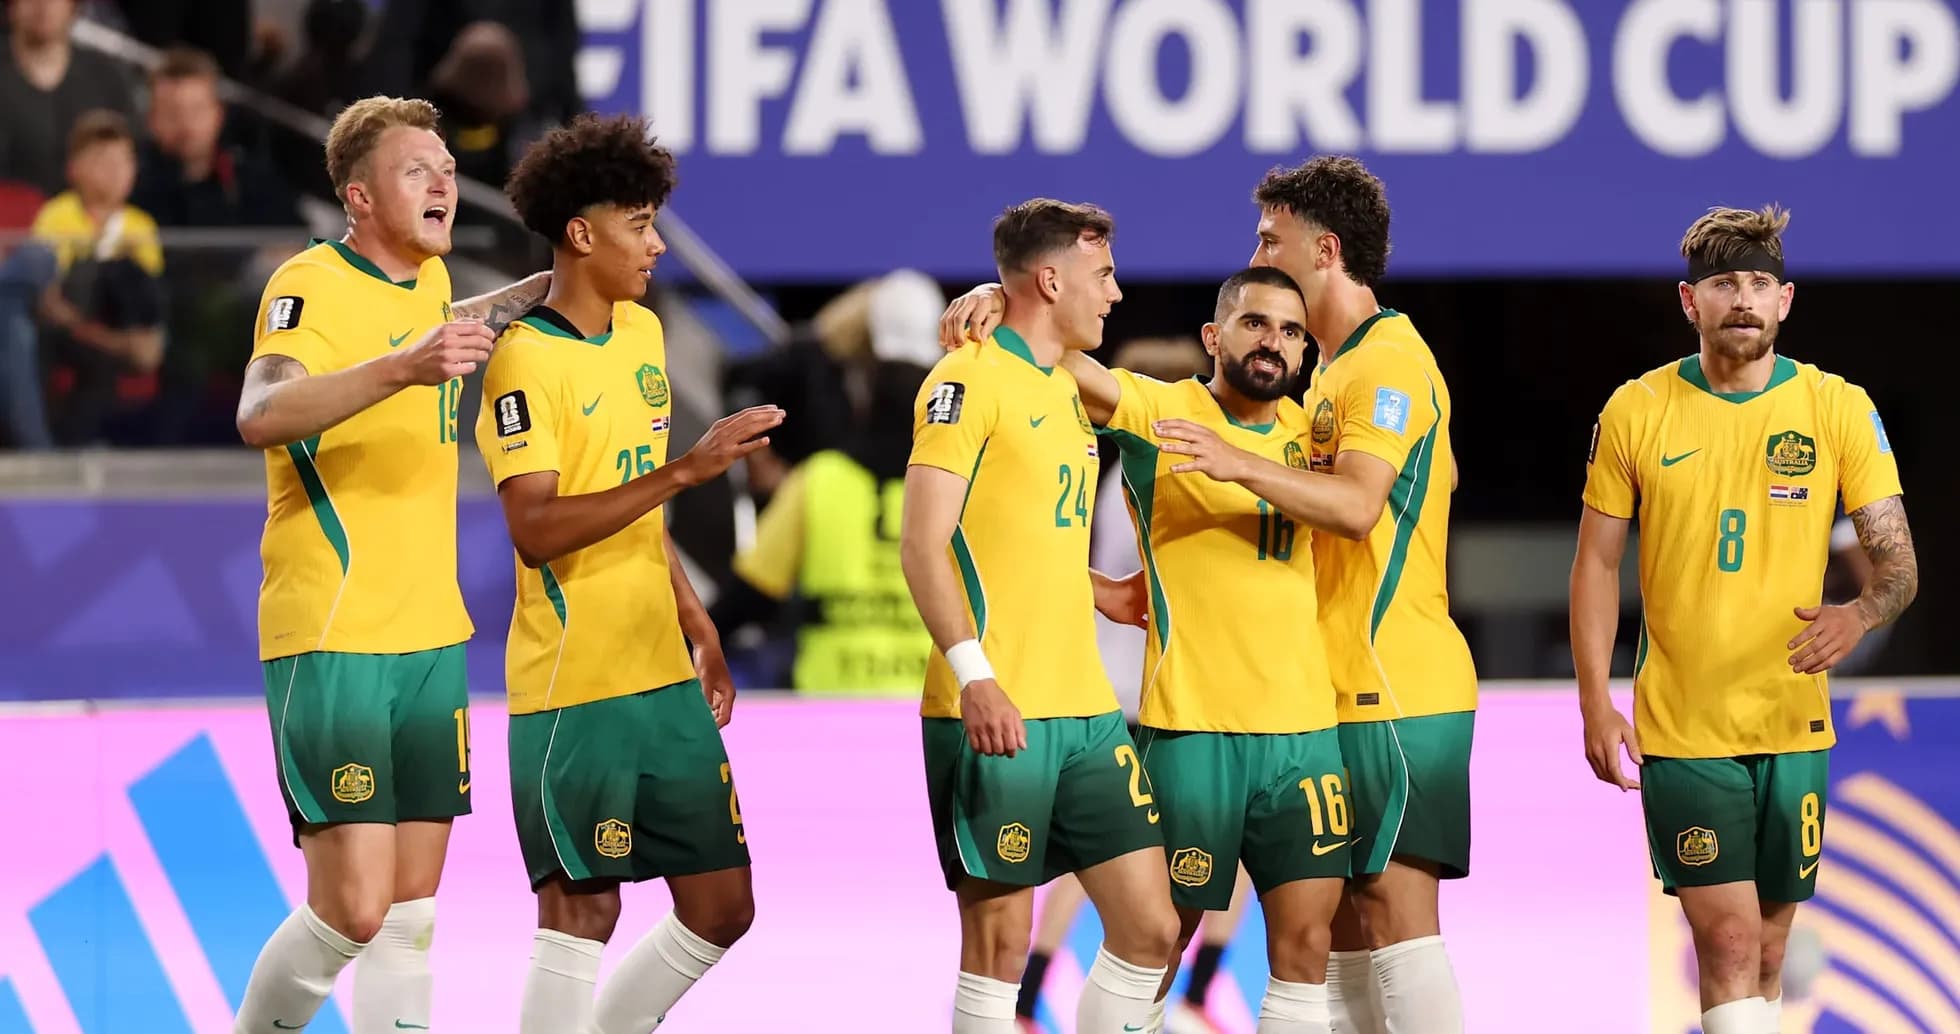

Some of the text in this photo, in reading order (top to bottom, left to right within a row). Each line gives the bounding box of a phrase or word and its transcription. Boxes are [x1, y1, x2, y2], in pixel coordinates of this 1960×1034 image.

[941, 0, 1590, 157] WORLD
[1611, 0, 1959, 159] CUP
[1055, 464, 1088, 527] 24
[1257, 498, 1295, 561] 16
[1717, 508, 1747, 573] 8
[1114, 744, 1154, 808] 2
[1298, 773, 1349, 837] 16
[1800, 792, 1821, 857] 8
